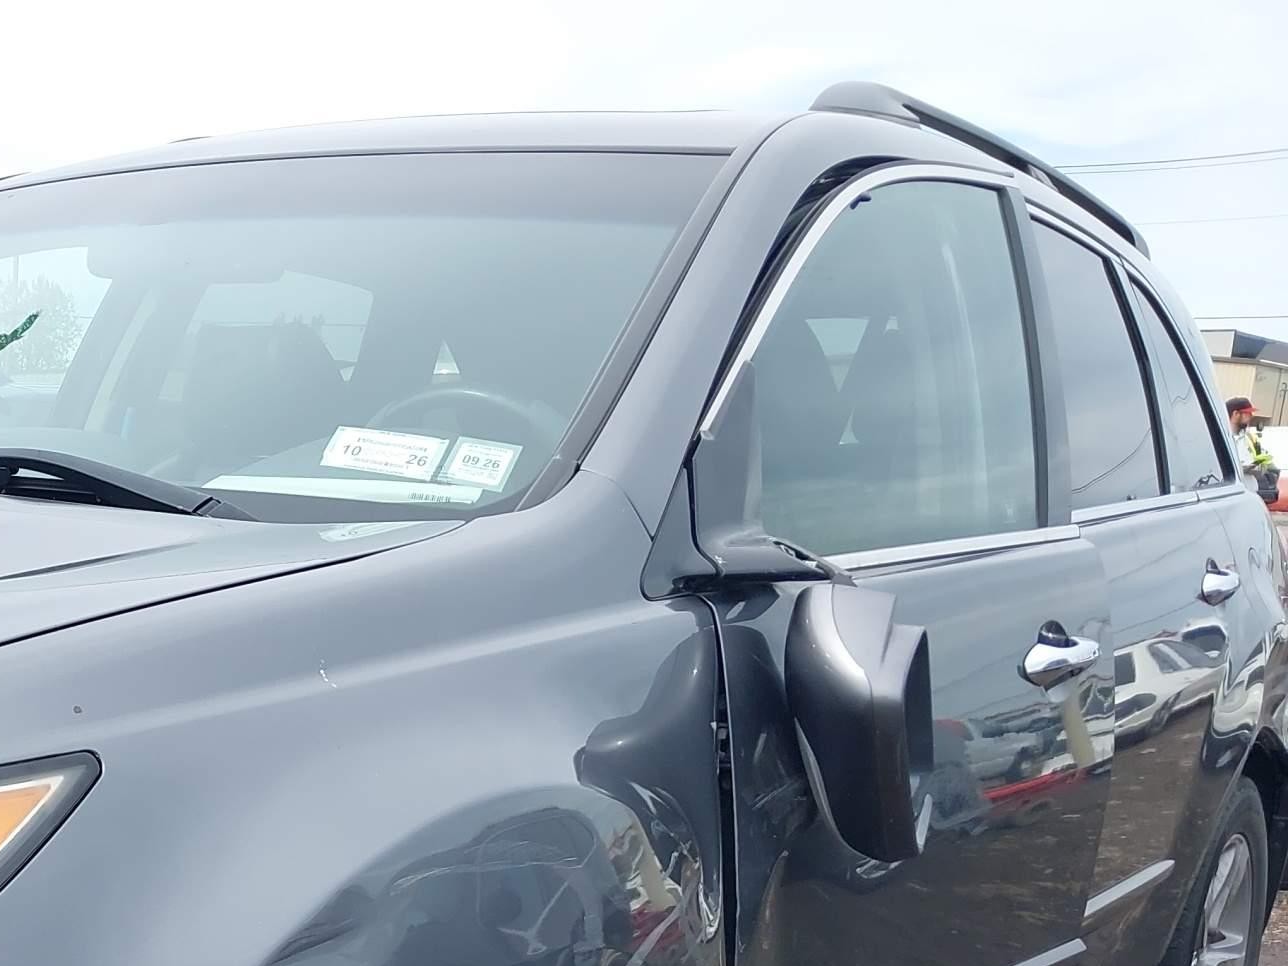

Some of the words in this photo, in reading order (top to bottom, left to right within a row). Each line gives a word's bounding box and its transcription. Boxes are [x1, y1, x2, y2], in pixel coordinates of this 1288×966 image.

[343, 444, 362, 457] 10
[405, 454, 428, 467] 26
[462, 454, 480, 466] 09
[482, 458, 501, 469] 26
